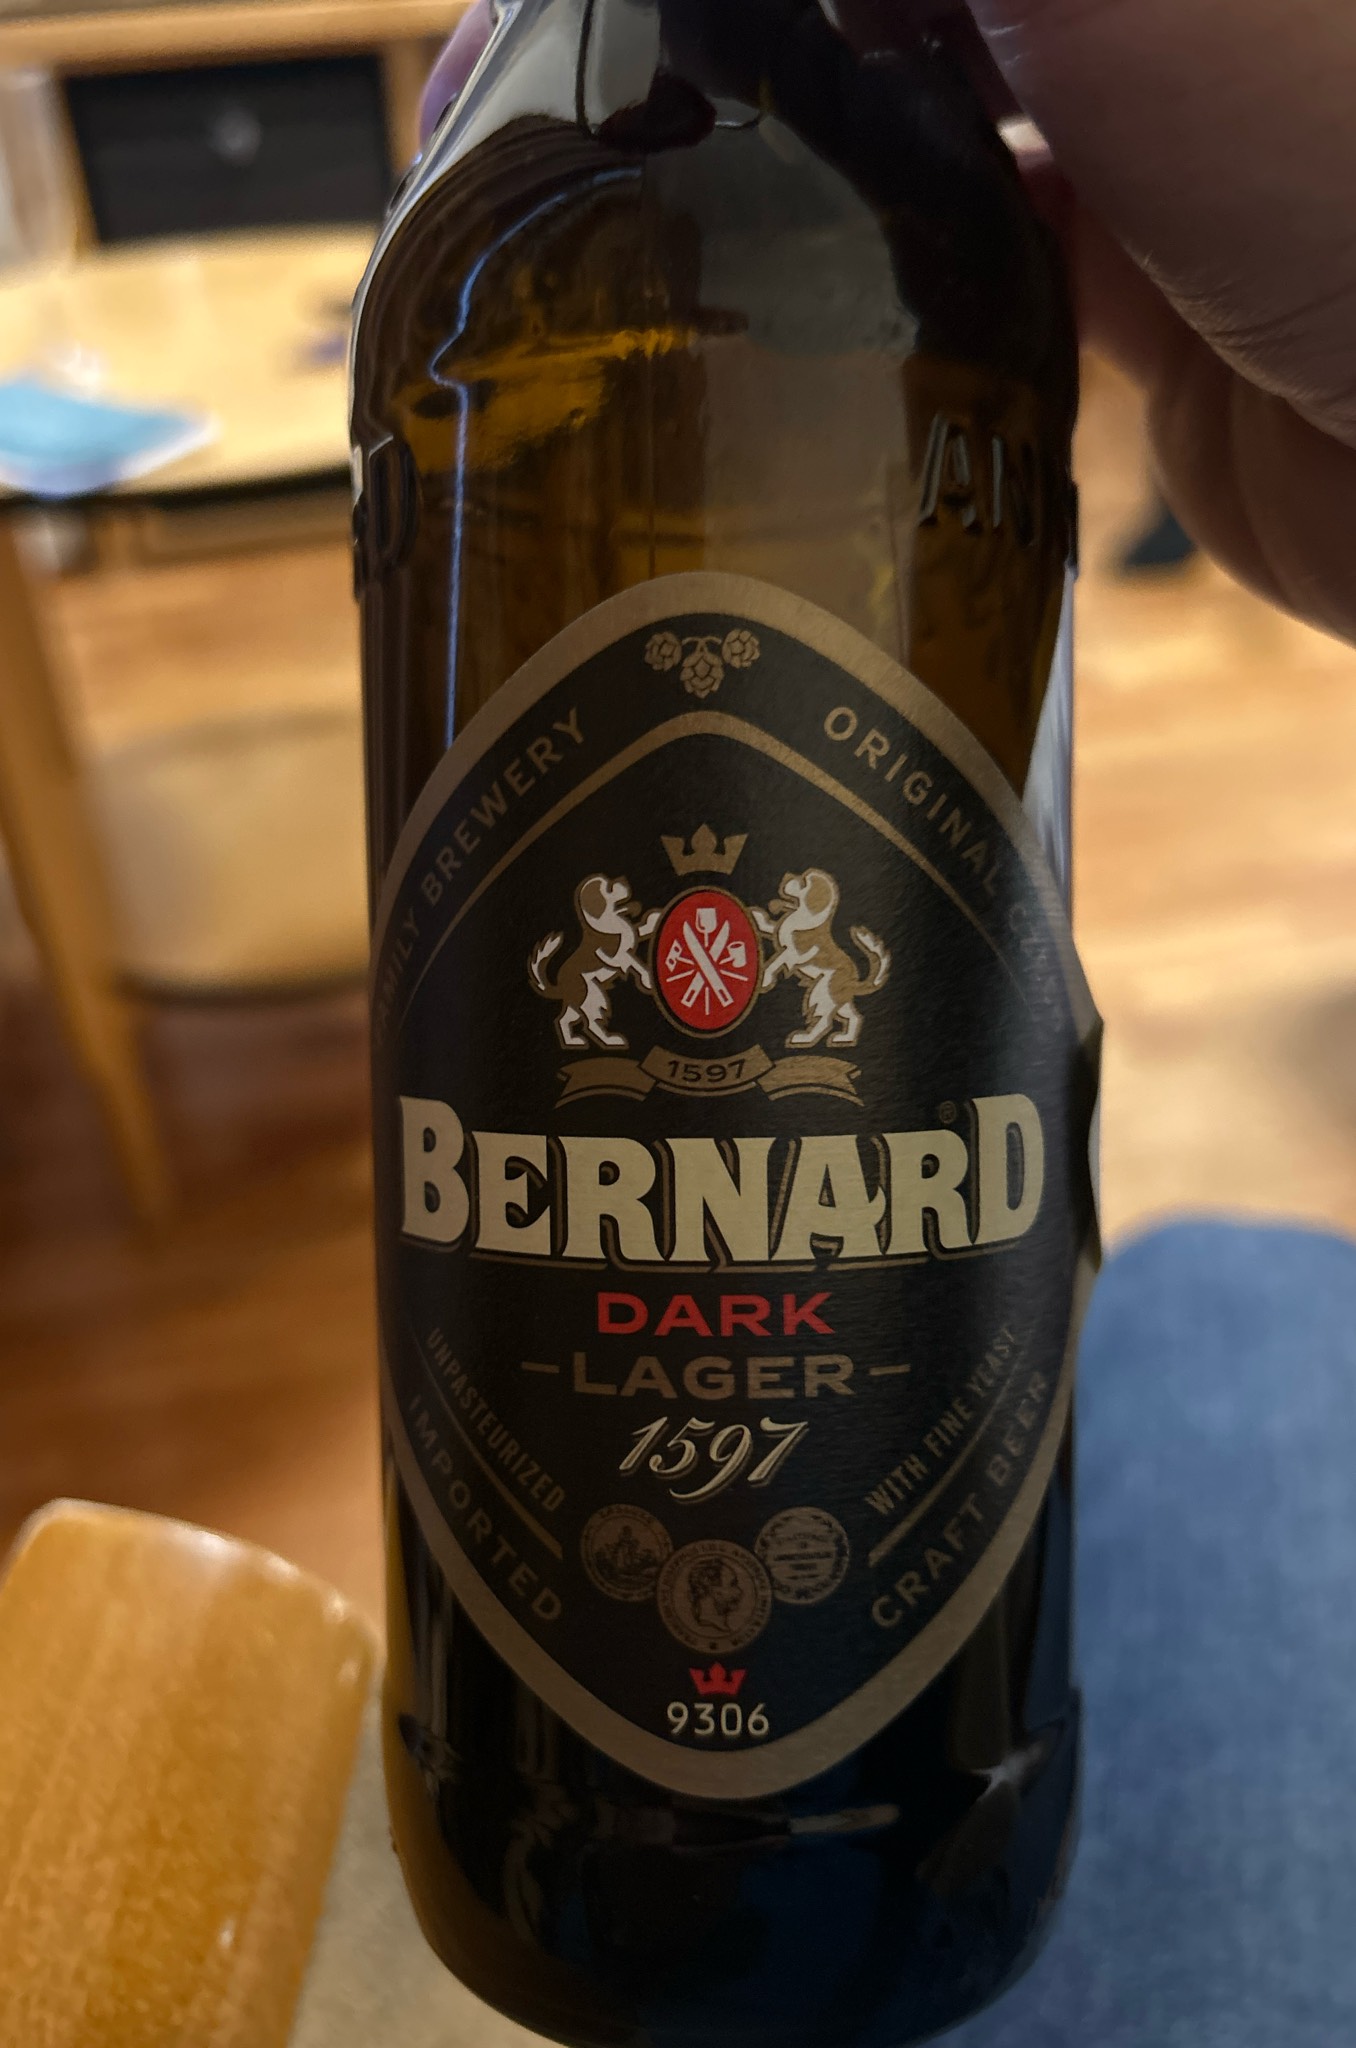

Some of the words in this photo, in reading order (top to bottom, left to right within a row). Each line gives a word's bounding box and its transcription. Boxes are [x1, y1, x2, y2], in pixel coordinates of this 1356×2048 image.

[420, 705, 585, 906] BREWERY
[823, 706, 1000, 897] ORIGINAL
[668, 1060, 746, 1083] 1597
[400, 1092, 1046, 1270] BERNARD
[573, 1351, 856, 1400] LAGER
[597, 1290, 836, 1338] DARK
[409, 1393, 563, 1620] IMPORTED
[426, 1327, 567, 1512] UNPASTEURIZED
[619, 1415, 810, 1503] 1597
[865, 1453, 929, 1516] WITH
[921, 1397, 975, 1459] FINE
[965, 1325, 1017, 1398] YEAST
[870, 1491, 984, 1629] CRAFT
[985, 1369, 1048, 1487] BEER
[665, 1700, 770, 1737] 9306
